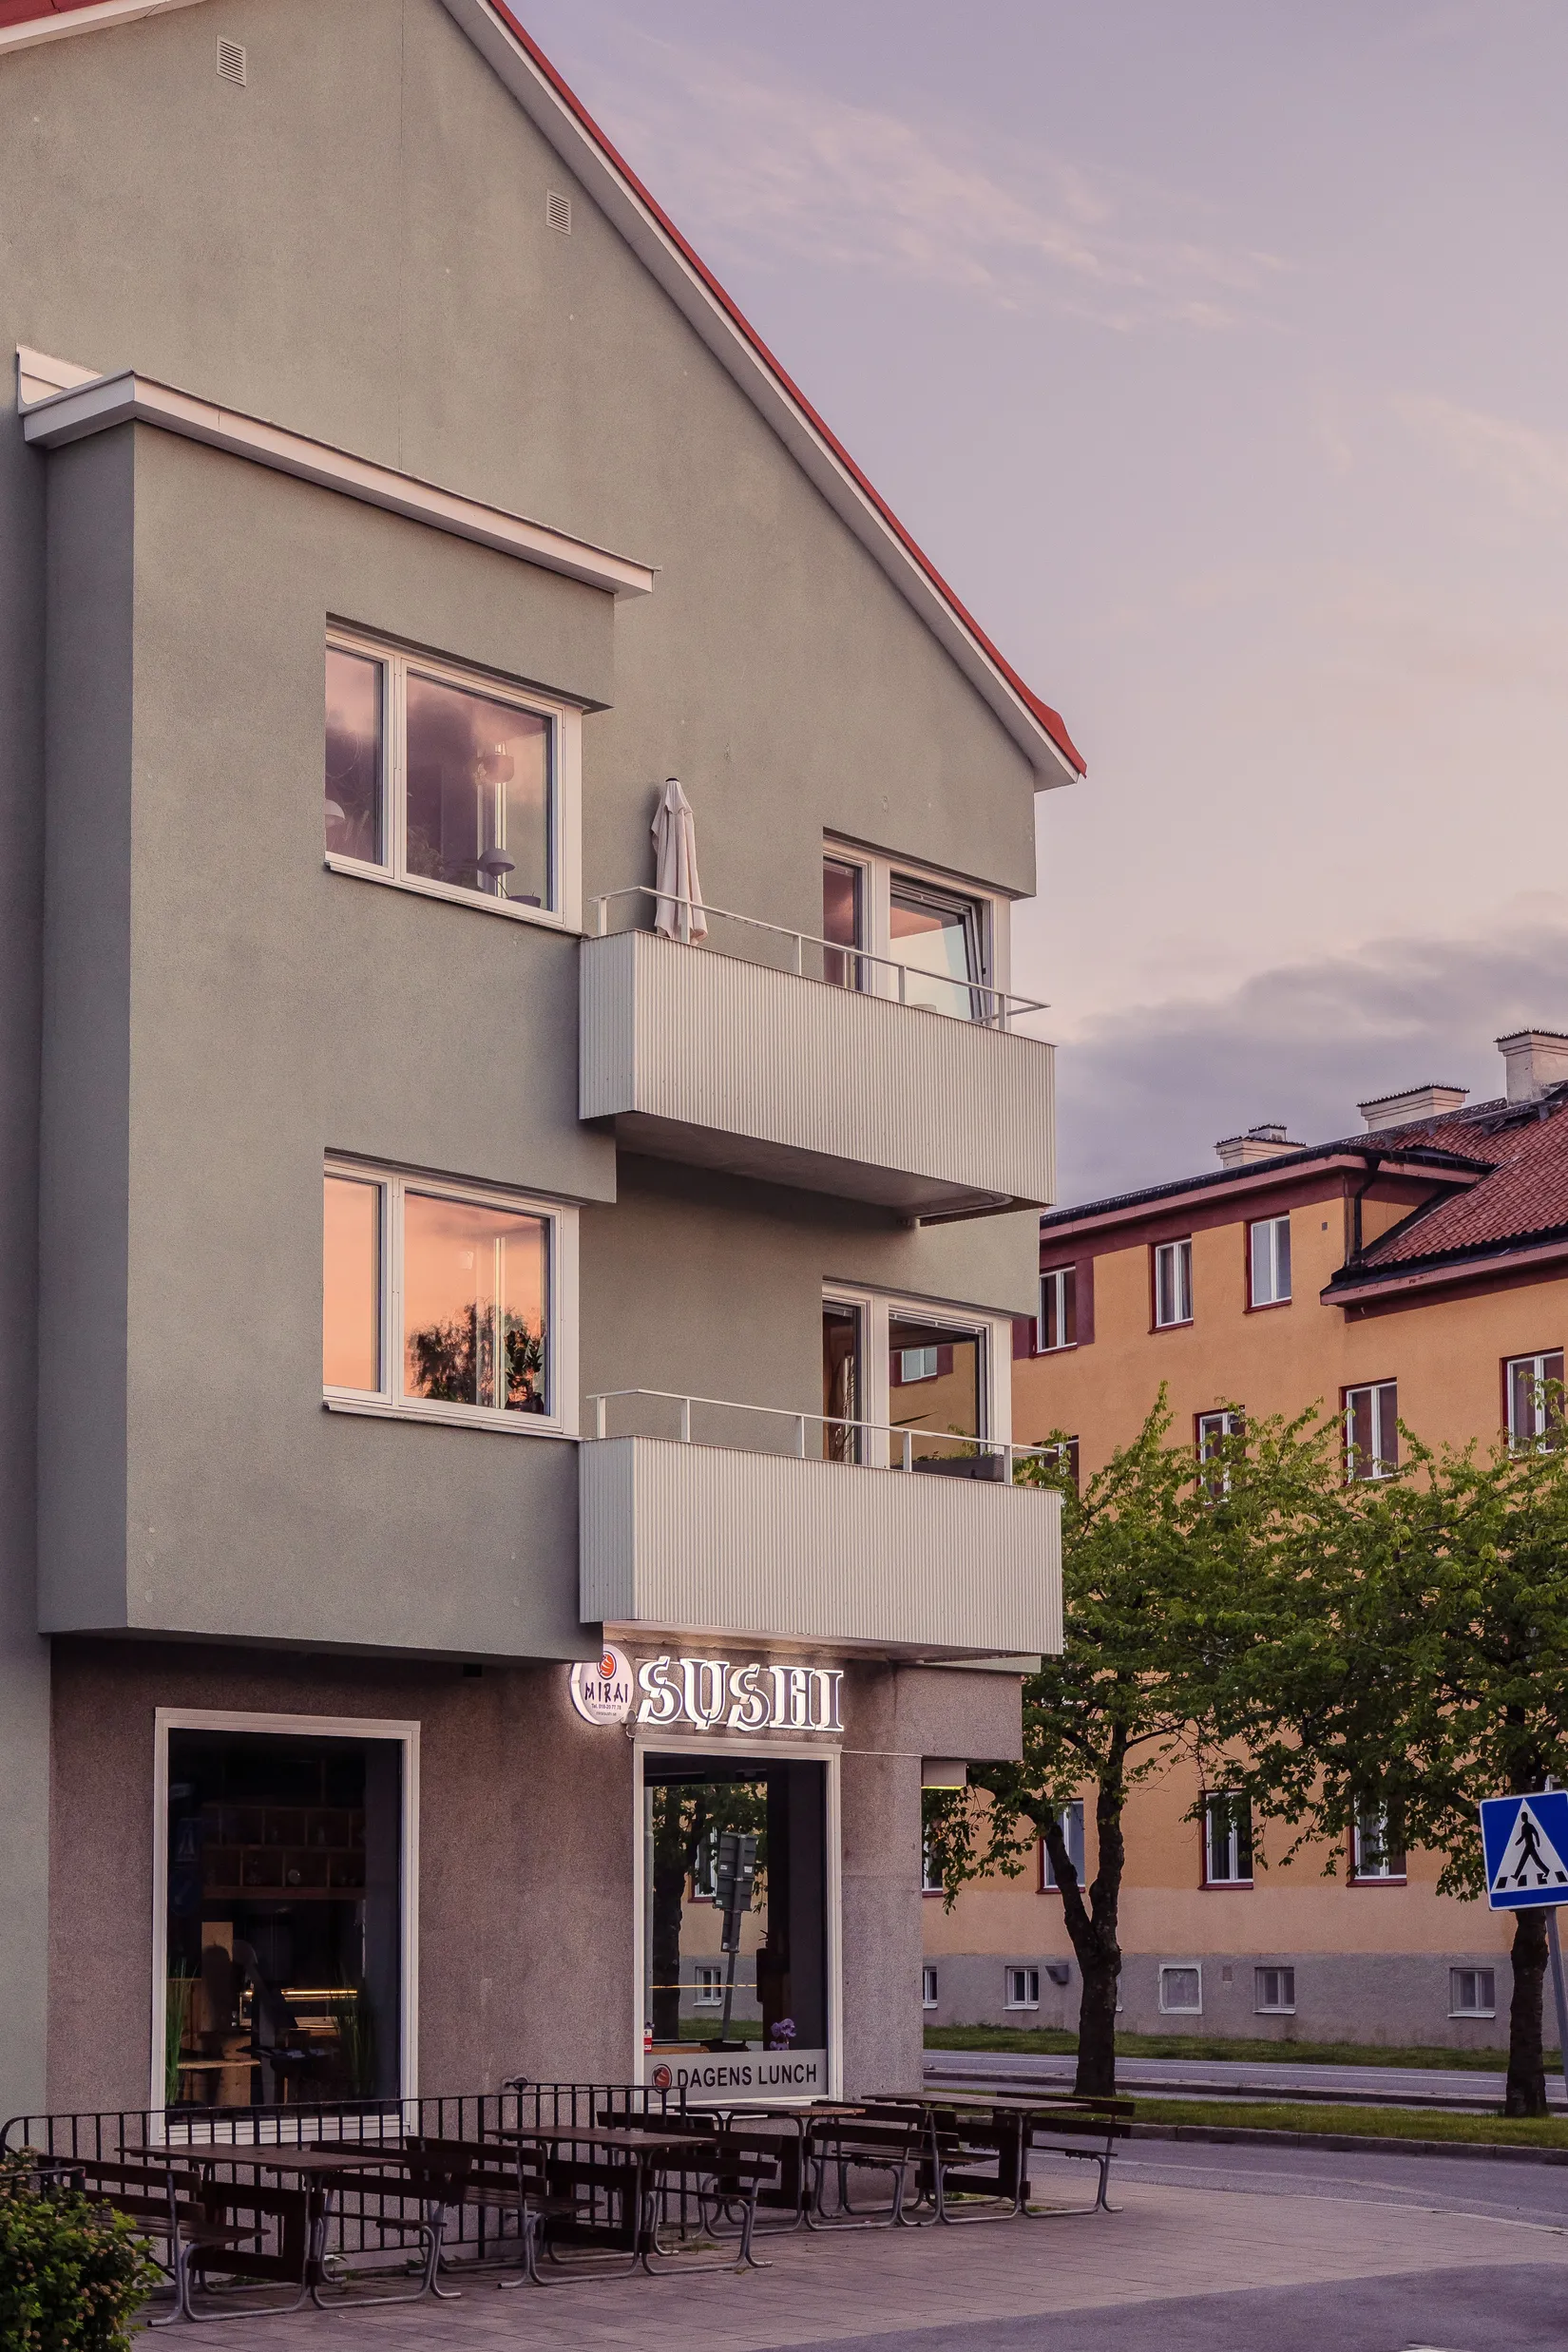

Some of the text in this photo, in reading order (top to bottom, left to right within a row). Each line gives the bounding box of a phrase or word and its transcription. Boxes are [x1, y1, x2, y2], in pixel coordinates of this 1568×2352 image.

[584, 1682, 628, 1703] MIRAI
[638, 1655, 844, 1731] SUSHI
[678, 2064, 816, 2088] DAGENS LUNCH
